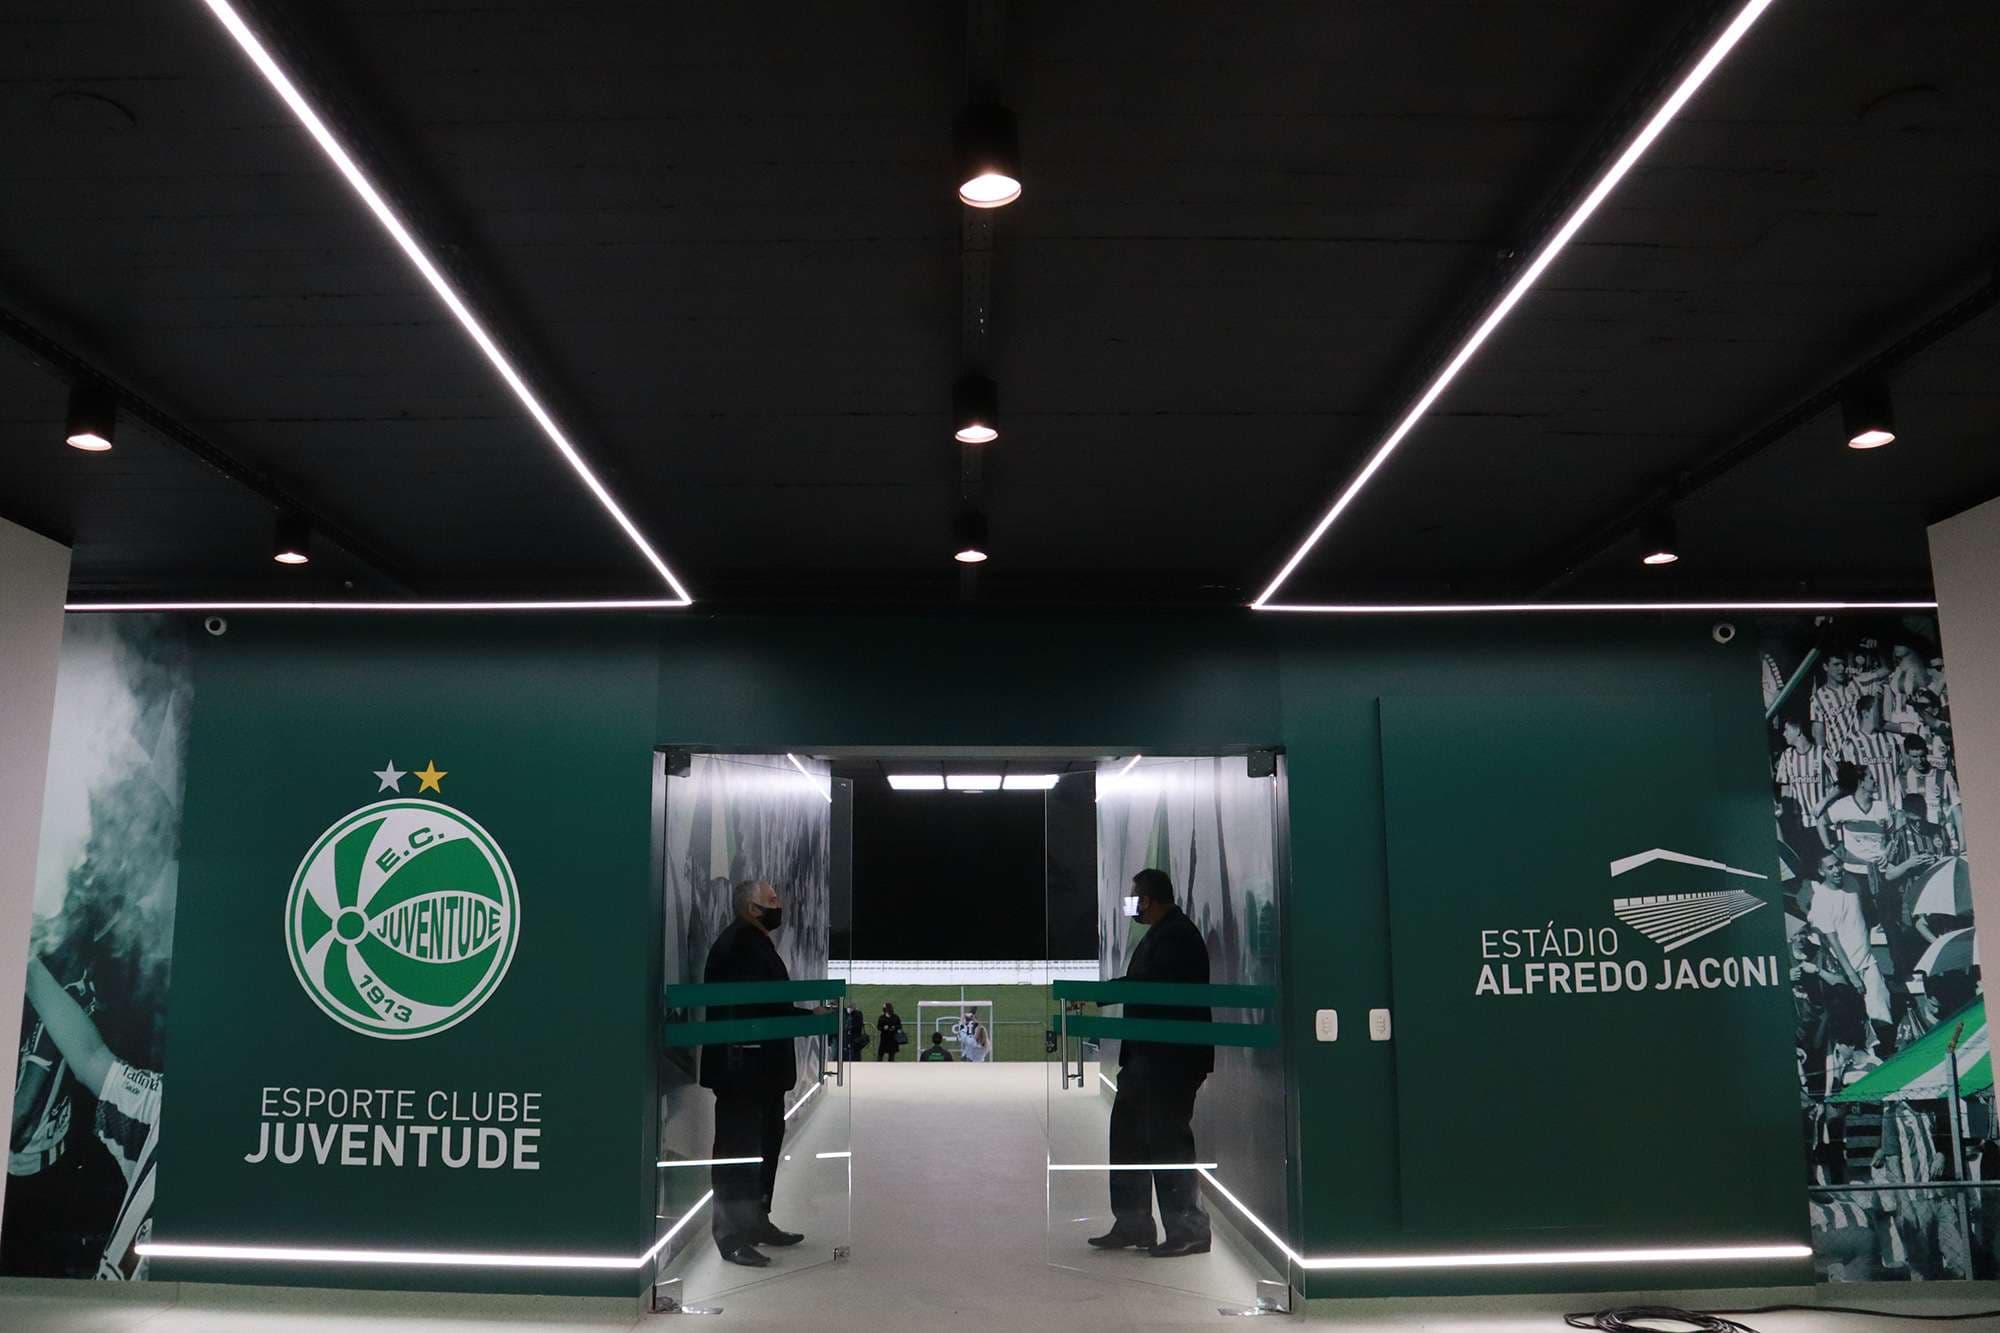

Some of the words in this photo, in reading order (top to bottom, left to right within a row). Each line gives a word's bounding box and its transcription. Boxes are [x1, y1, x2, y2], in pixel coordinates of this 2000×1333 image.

[375, 826, 445, 873] E.C.
[376, 895, 502, 960] JUVENTUDE
[1480, 920, 1619, 958] ESTÁDIO
[358, 974, 413, 1023] 1913
[1475, 959, 1649, 995] ALFREDO
[1655, 955, 1779, 990] JACONI
[261, 1087, 416, 1119] ESPORTE
[427, 1090, 542, 1122] CLUBE
[244, 1122, 541, 1170] JUVENTUDE
